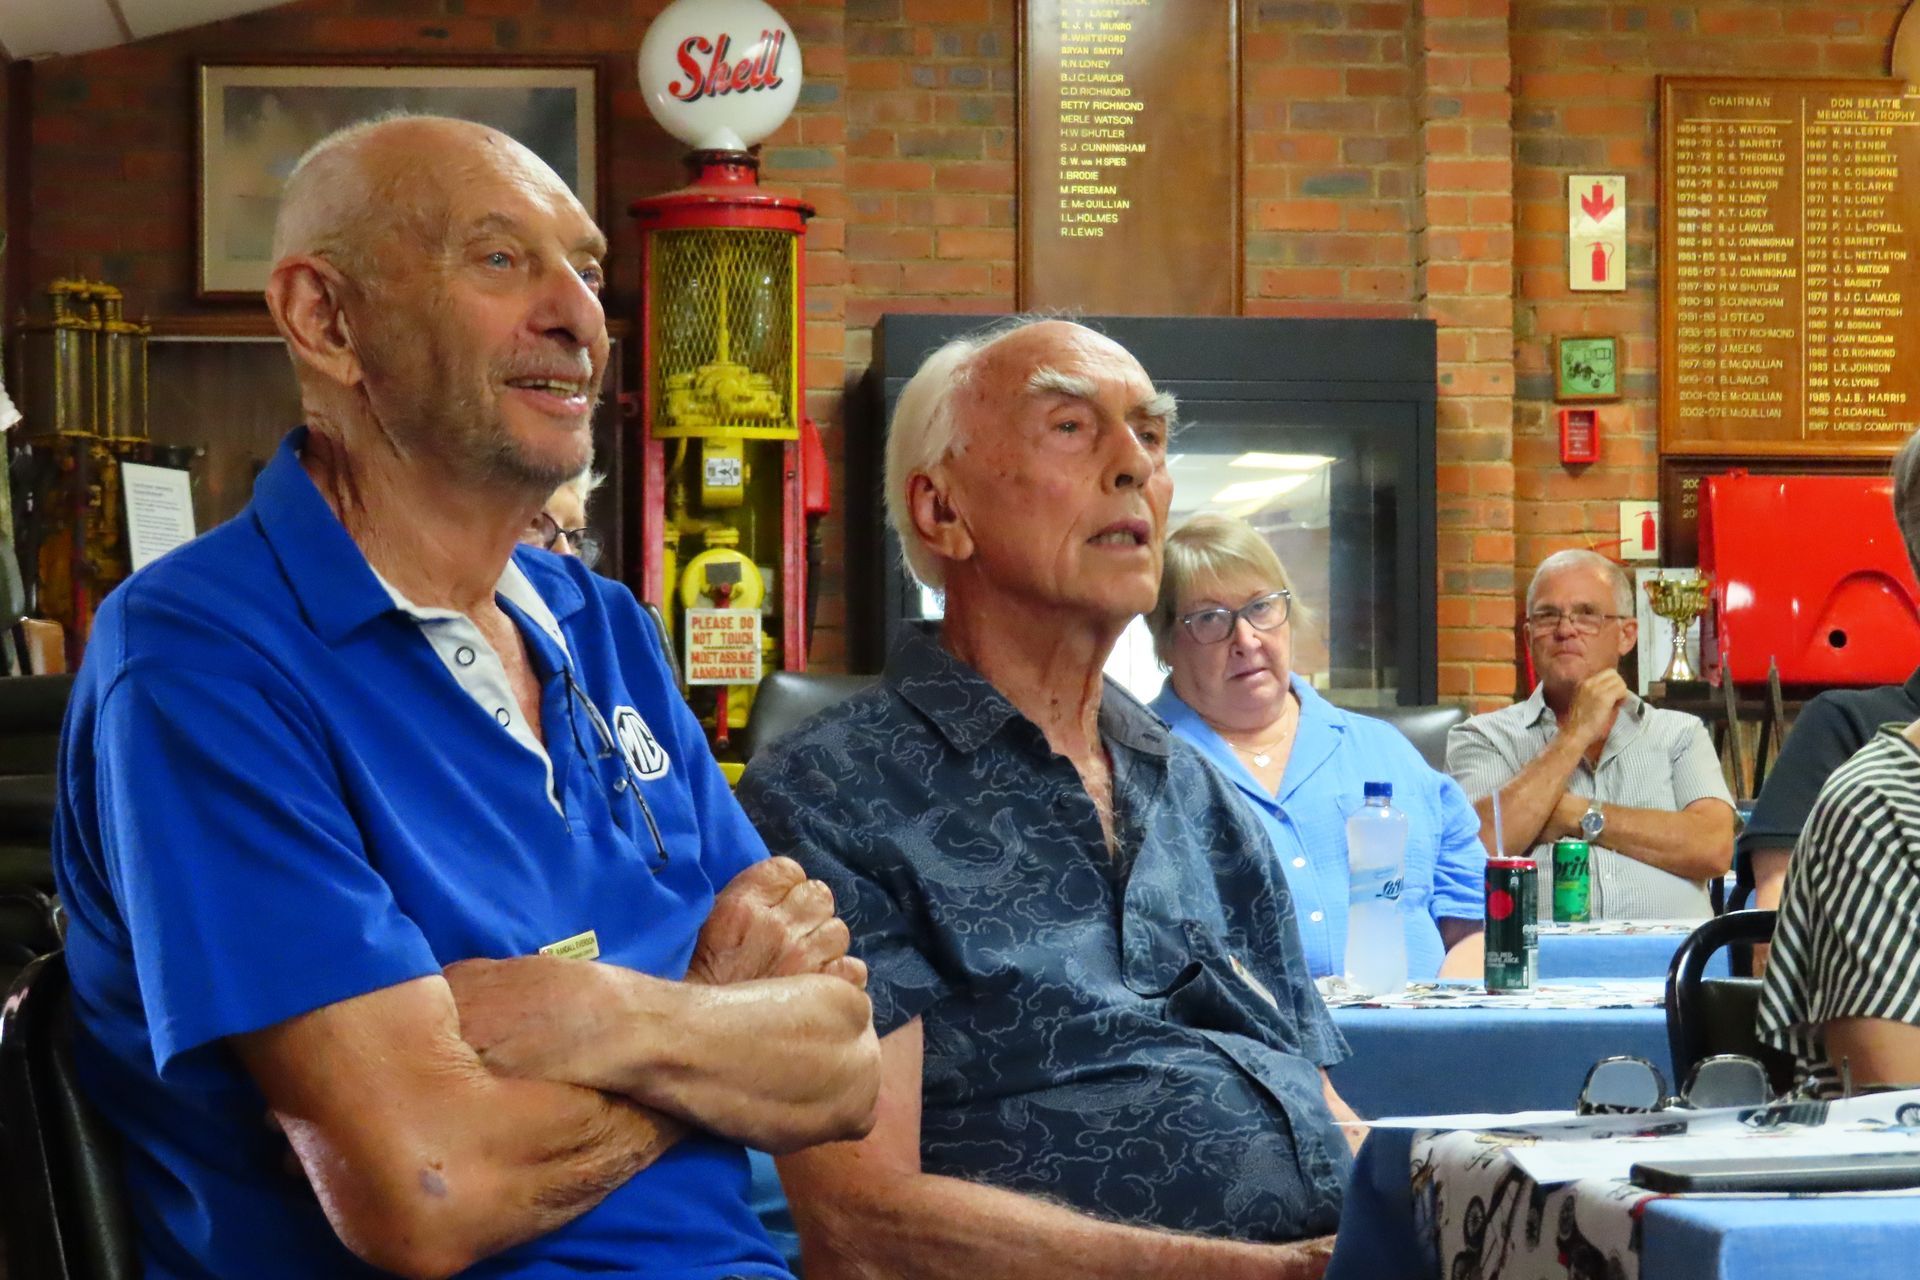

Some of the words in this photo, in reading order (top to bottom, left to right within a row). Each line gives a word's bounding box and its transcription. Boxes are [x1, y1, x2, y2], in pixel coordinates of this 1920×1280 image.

[1100, 22, 1132, 31] MUNRO
[1062, 46, 1089, 54] BRYAN
[1094, 47, 1124, 55] SMITH
[668, 29, 785, 102] Shell
[1061, 101, 1090, 109] BETTY
[1093, 101, 1144, 111] RICHMOND
[1709, 96, 1771, 107] CHAIRMAN
[1831, 98, 1853, 108] DON
[1858, 98, 1901, 109] BEATTIE
[1061, 115, 1090, 123] MERLE
[1094, 116, 1133, 124] WATSON
[1817, 109, 1869, 120] MEMORIAL
[1876, 110, 1915, 121] TROPHY
[1739, 125, 1776, 134] WATSON
[1855, 127, 1893, 136] LESTER
[1081, 144, 1146, 152] CUNNINGHAM
[1739, 140, 1782, 149] BARRETT
[1855, 140, 1887, 150] EXNER
[1740, 153, 1785, 162] THEOBALD
[1855, 154, 1898, 163] BARRETT
[1740, 166, 1784, 176] OSBORNE
[1855, 168, 1899, 177] OSBORNE
[1740, 181, 1778, 190] LAWLOR
[1855, 182, 1894, 191] CLARKE
[1740, 194, 1767, 204] LONEY
[1855, 196, 1885, 204] LONEY
[1739, 209, 1768, 218] LACEY
[1855, 209, 1885, 218] LACEY
[1739, 223, 1774, 233] LAWLOR
[1867, 223, 1903, 233] POWELL
[1739, 239, 1794, 248] CUNNINGHAM
[1807, 237, 1827, 245] 1974
[1844, 237, 1886, 246] BARRETT
[1855, 251, 1907, 260] NETTLETON
[1740, 268, 1796, 278] CUNNINGHAM
[1856, 265, 1890, 274] WATSON
[1808, 278, 1827, 287] 1977
[1865, 293, 1900, 303] LAWLOR
[1720, 329, 1747, 338] BETTY
[1750, 329, 1794, 338] RICHMOND
[1833, 335, 1855, 343] JOAN
[1858, 335, 1894, 343] MELDRUM
[1809, 393, 1831, 402] 1985
[1868, 393, 1906, 403] HARRIS
[1834, 422, 1862, 431] LADIES
[1864, 422, 1915, 432] COMMITTEE
[691, 616, 734, 629] PLEASE
[740, 616, 754, 629] DO
[693, 632, 713, 644] NOT
[720, 632, 753, 644] TOUCH
